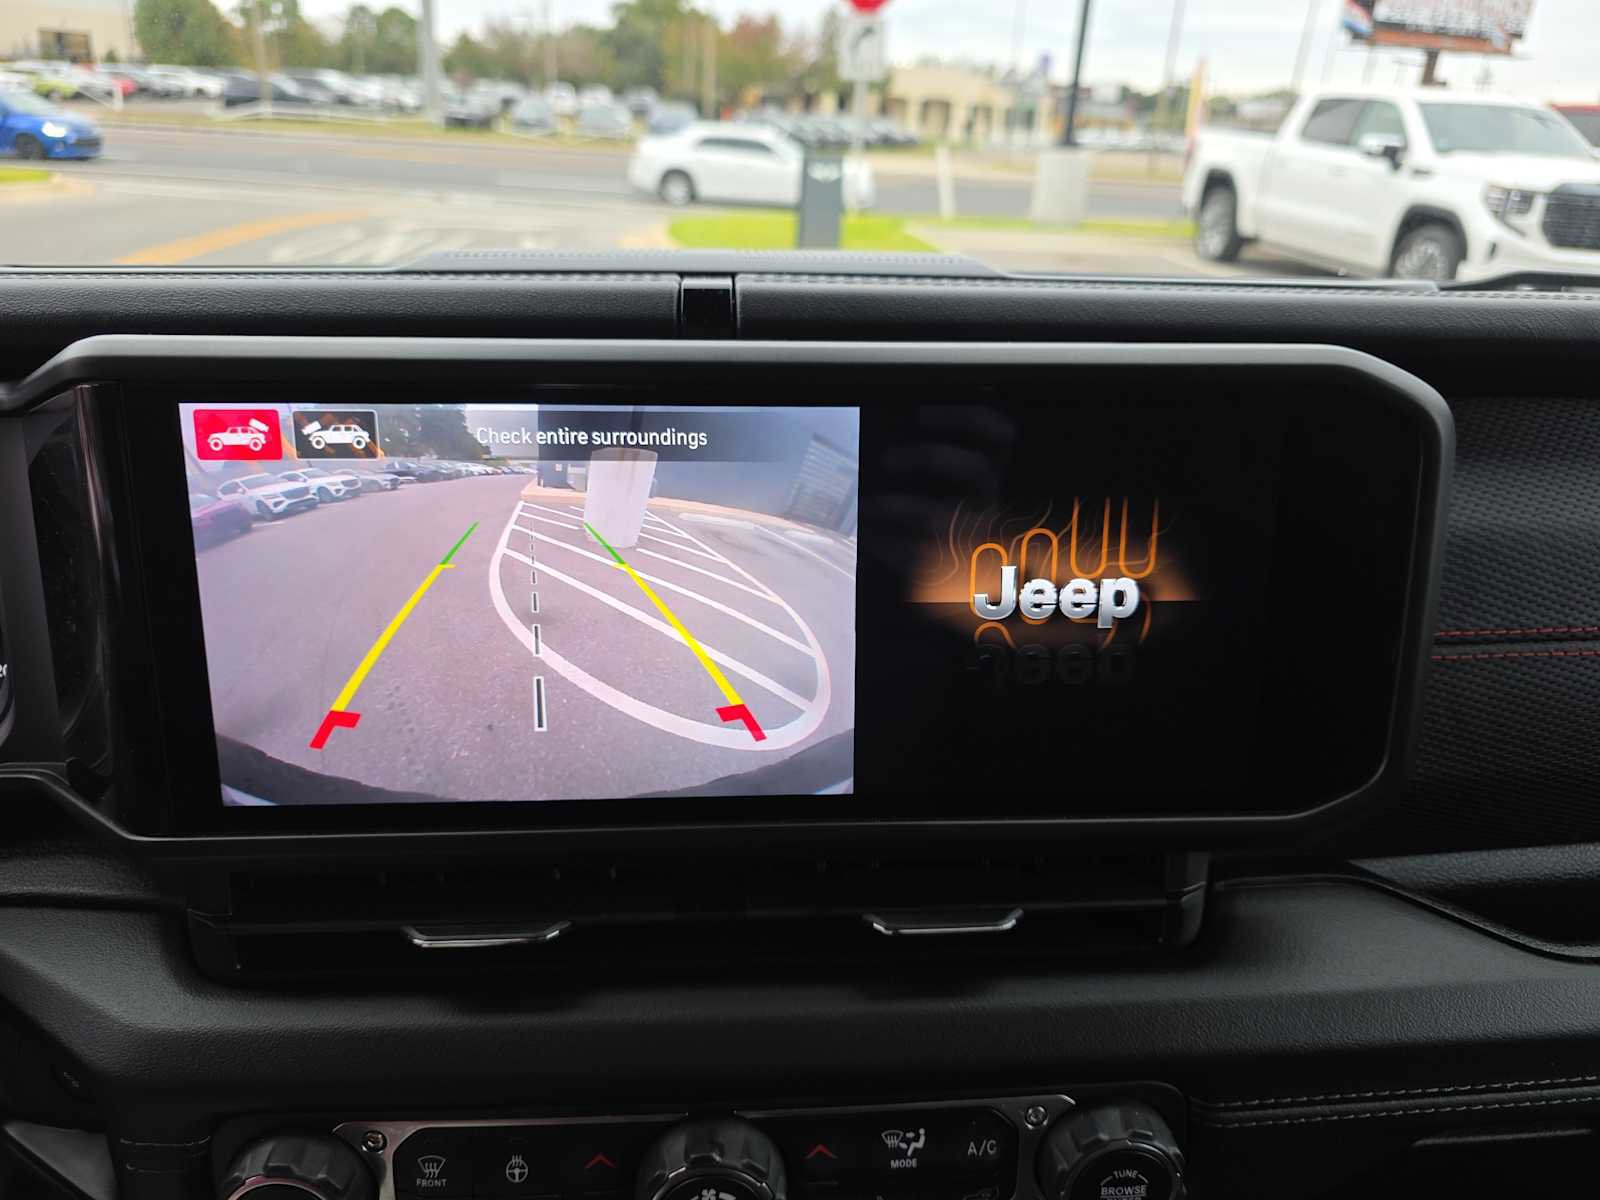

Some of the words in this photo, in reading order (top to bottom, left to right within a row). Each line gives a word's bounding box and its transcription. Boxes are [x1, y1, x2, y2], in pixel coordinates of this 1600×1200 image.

[476, 426, 532, 445] Check
[535, 427, 589, 446] entire
[591, 428, 708, 449] surroundings
[973, 565, 1140, 628] Jeep
[967, 1139, 997, 1157] A/C
[890, 1158, 918, 1168] MODE
[1112, 1168, 1139, 1180] TUNE
[416, 1178, 447, 1187] FRONT
[1100, 1184, 1149, 1197] BROWSE
